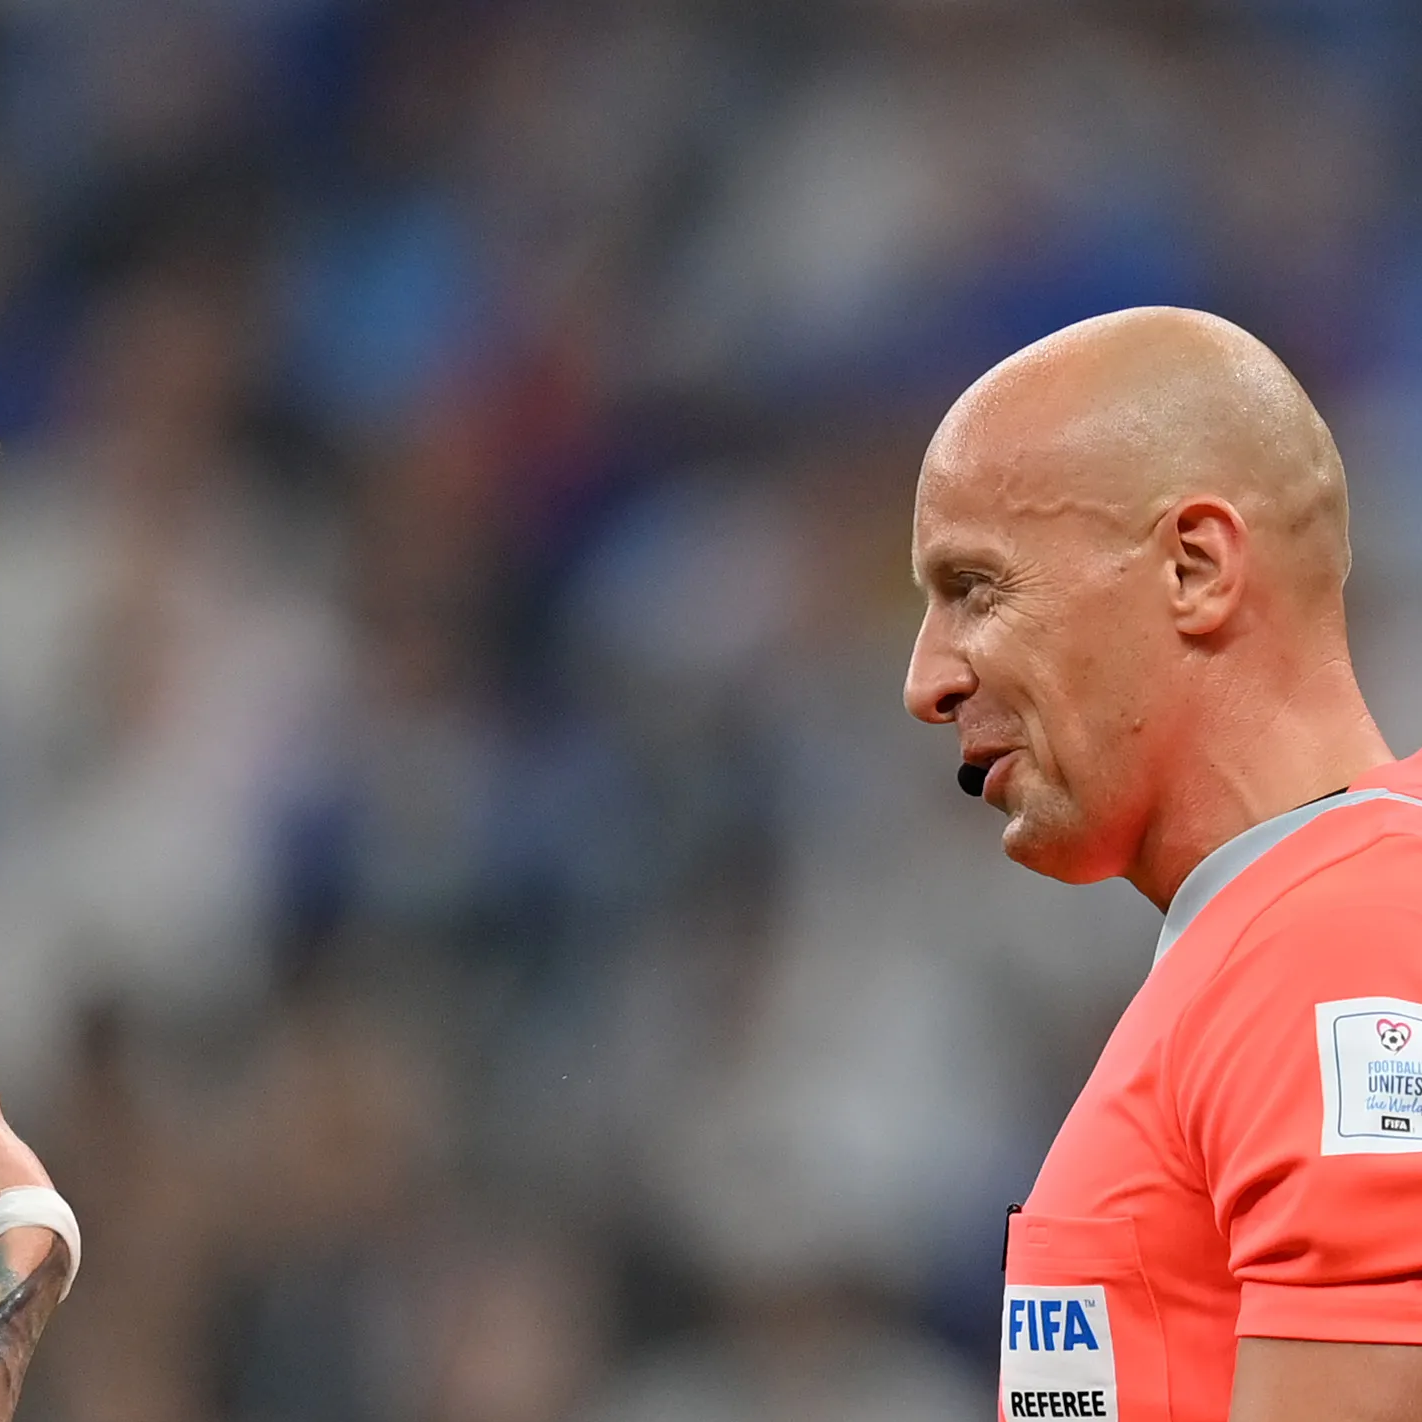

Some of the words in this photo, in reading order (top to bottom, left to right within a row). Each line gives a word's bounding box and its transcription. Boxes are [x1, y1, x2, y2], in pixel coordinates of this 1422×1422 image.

[1366, 1096, 1386, 1113] the
[1384, 1118, 1408, 1131] FIFA
[1008, 1299, 1099, 1351] FIFA
[1011, 1390, 1106, 1418] REFEREE
